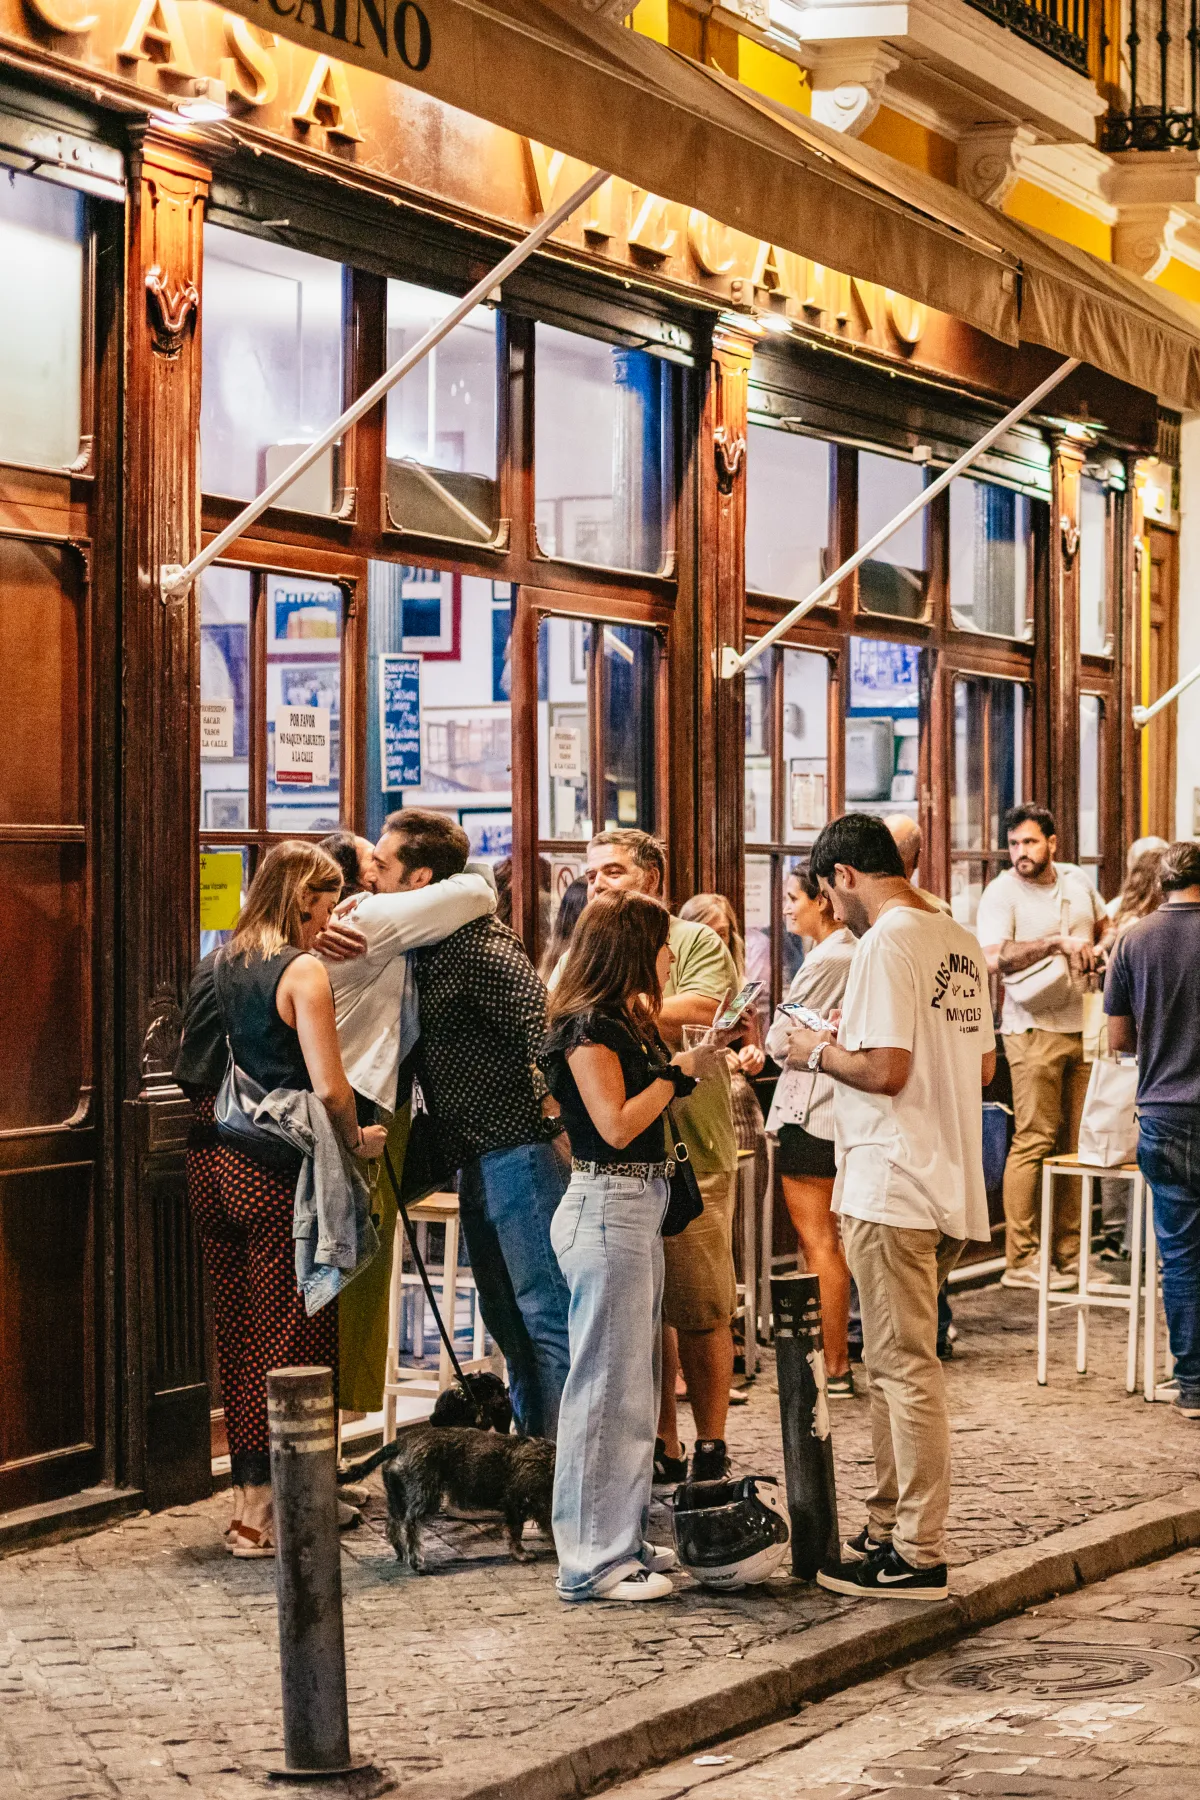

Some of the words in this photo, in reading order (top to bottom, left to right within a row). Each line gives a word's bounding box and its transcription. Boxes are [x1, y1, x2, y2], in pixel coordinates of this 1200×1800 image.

[200, 705, 227, 713] ROHIBIDO
[203, 716, 221, 725] SACAR
[290, 713, 300, 727] POR
[300, 713, 316, 728] FAVOR
[204, 728, 220, 736] VASOS
[202, 740, 210, 748] LA
[210, 740, 228, 748] CALLE
[280, 733, 286, 744] NO
[286, 733, 302, 747] SAQUEN
[303, 734, 326, 746] TABURETES
[301, 751, 314, 763] CALLE
